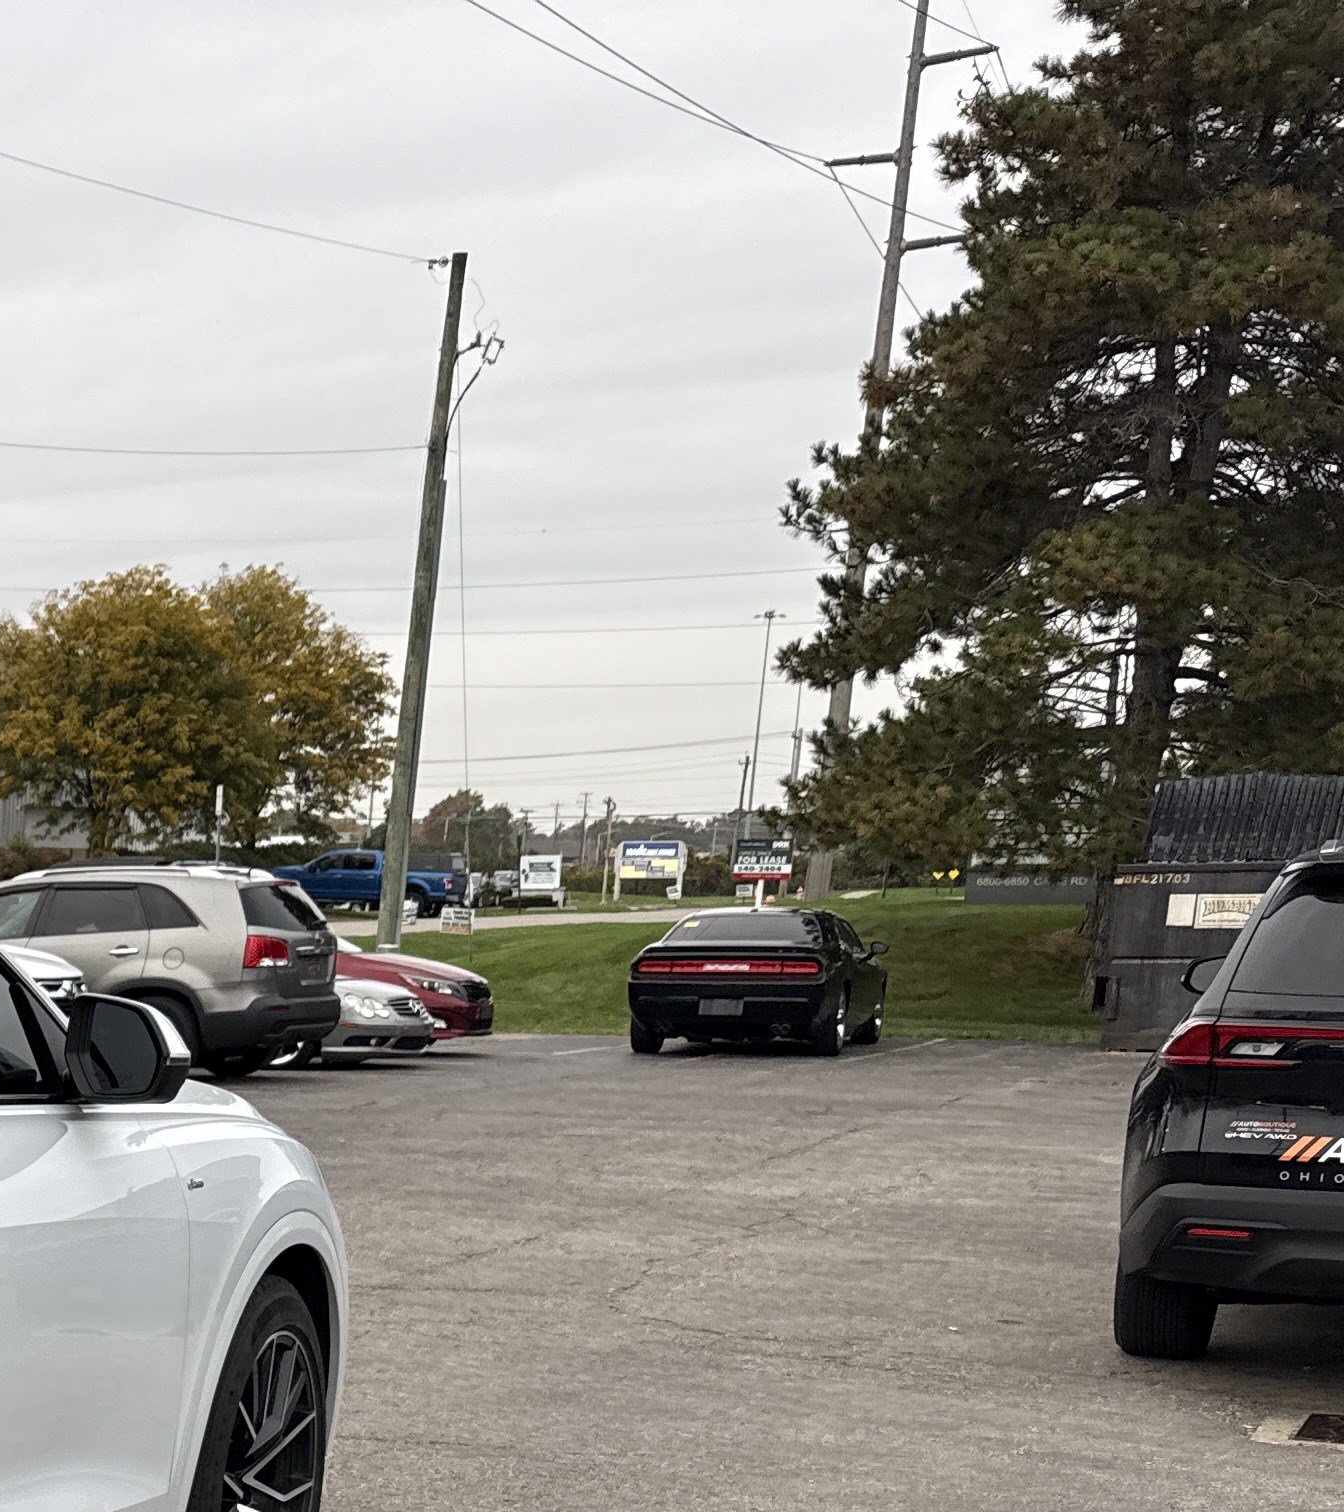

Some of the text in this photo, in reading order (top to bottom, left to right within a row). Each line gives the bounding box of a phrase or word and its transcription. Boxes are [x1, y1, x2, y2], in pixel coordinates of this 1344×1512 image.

[738, 855, 787, 864] FOR LEASE
[1070, 876, 1089, 886] RD
[1279, 1170, 1344, 1184] OHIO
